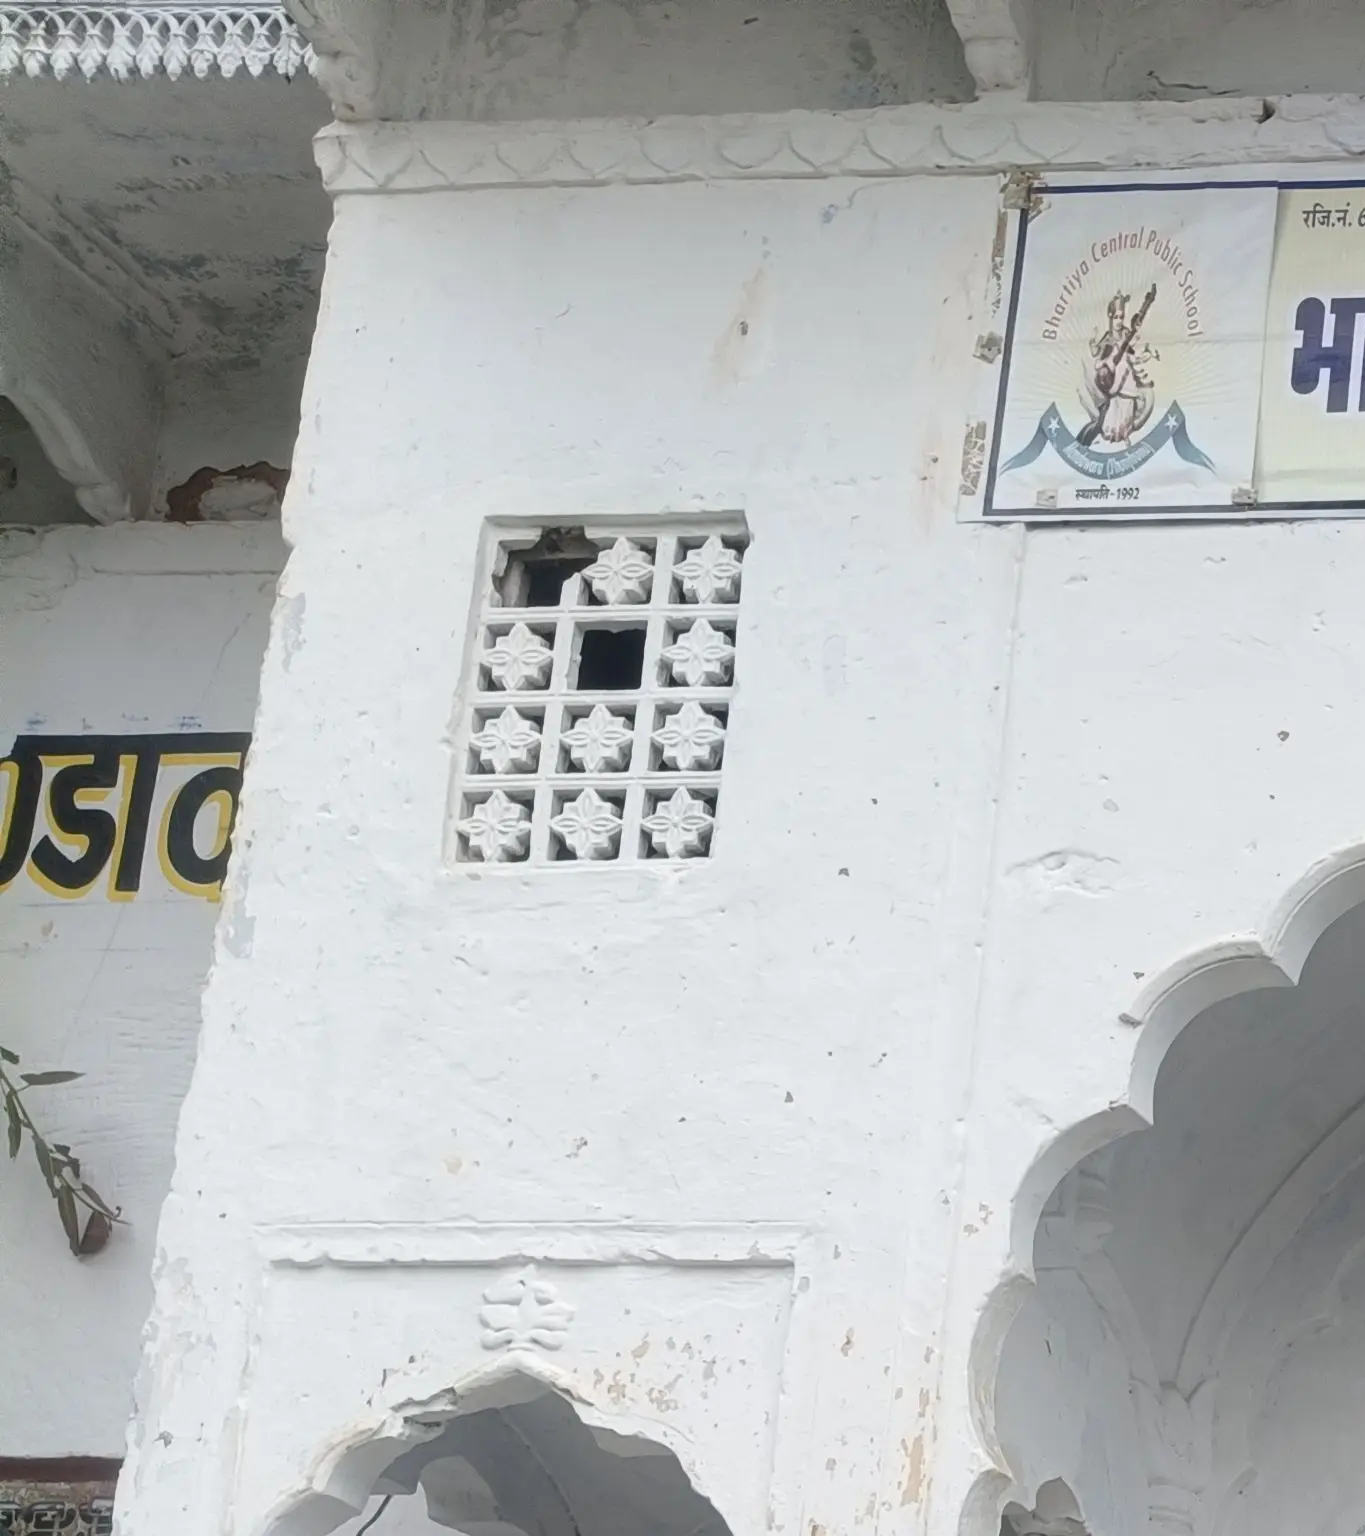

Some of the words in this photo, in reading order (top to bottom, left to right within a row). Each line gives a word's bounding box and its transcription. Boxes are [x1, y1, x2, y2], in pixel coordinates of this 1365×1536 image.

[1042, 260, 1090, 340] Bhartiya
[1091, 226, 1145, 263] Central
[1146, 230, 1183, 275] Public
[1178, 270, 1204, 338] School
